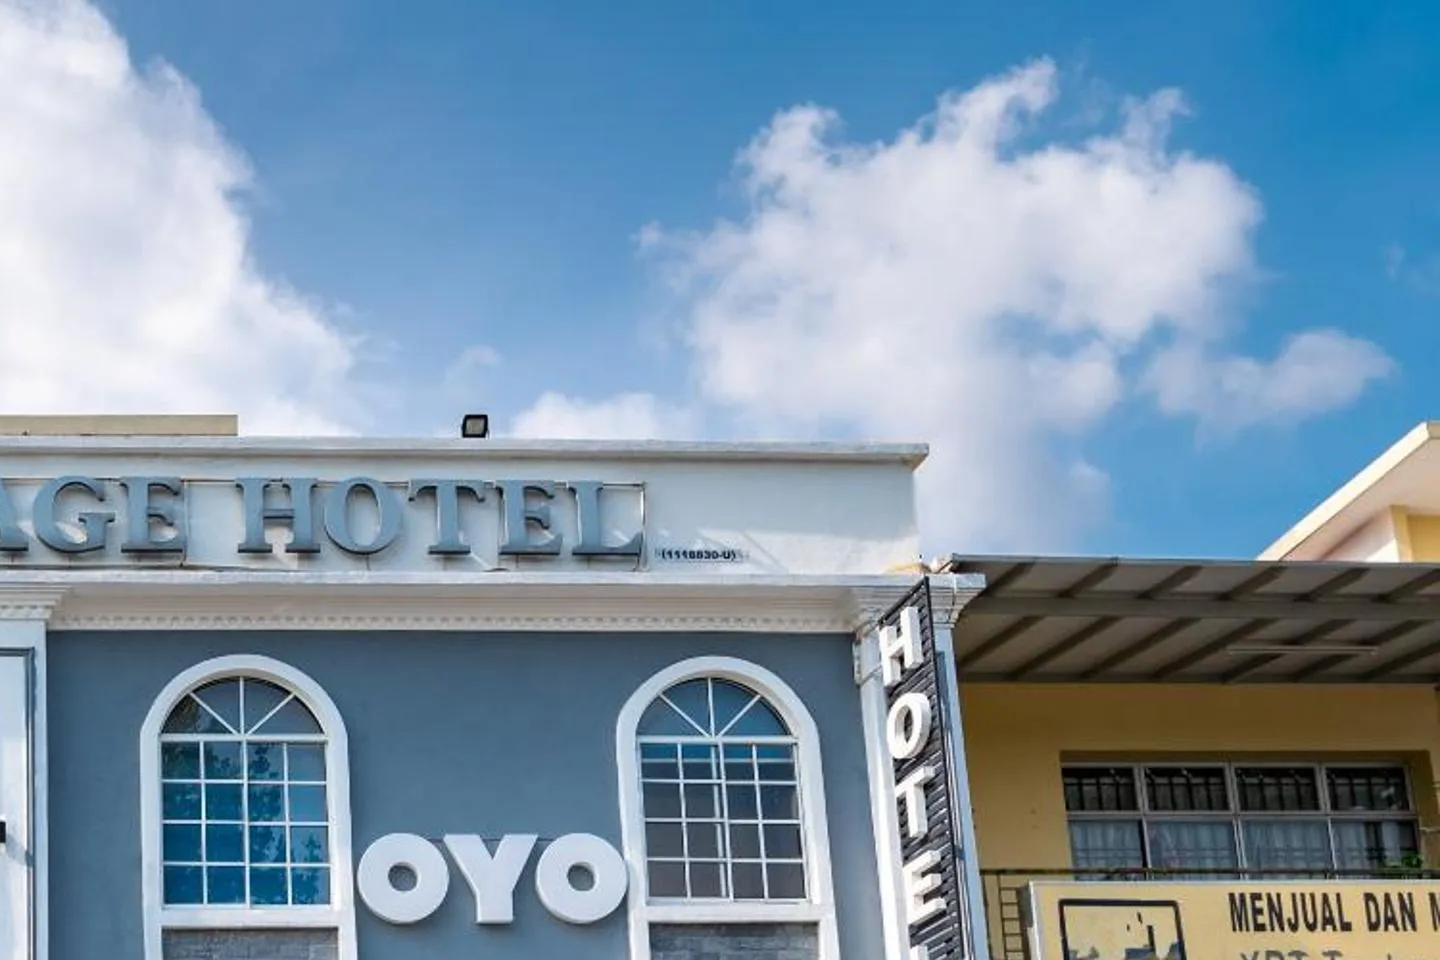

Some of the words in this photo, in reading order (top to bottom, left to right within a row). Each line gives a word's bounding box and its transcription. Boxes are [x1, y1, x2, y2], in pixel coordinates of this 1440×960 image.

[235, 477, 643, 555] HOTEL
[357, 832, 628, 924] OYO
[1228, 892, 1352, 932] MENJUAL
[1363, 892, 1417, 932] DAN
